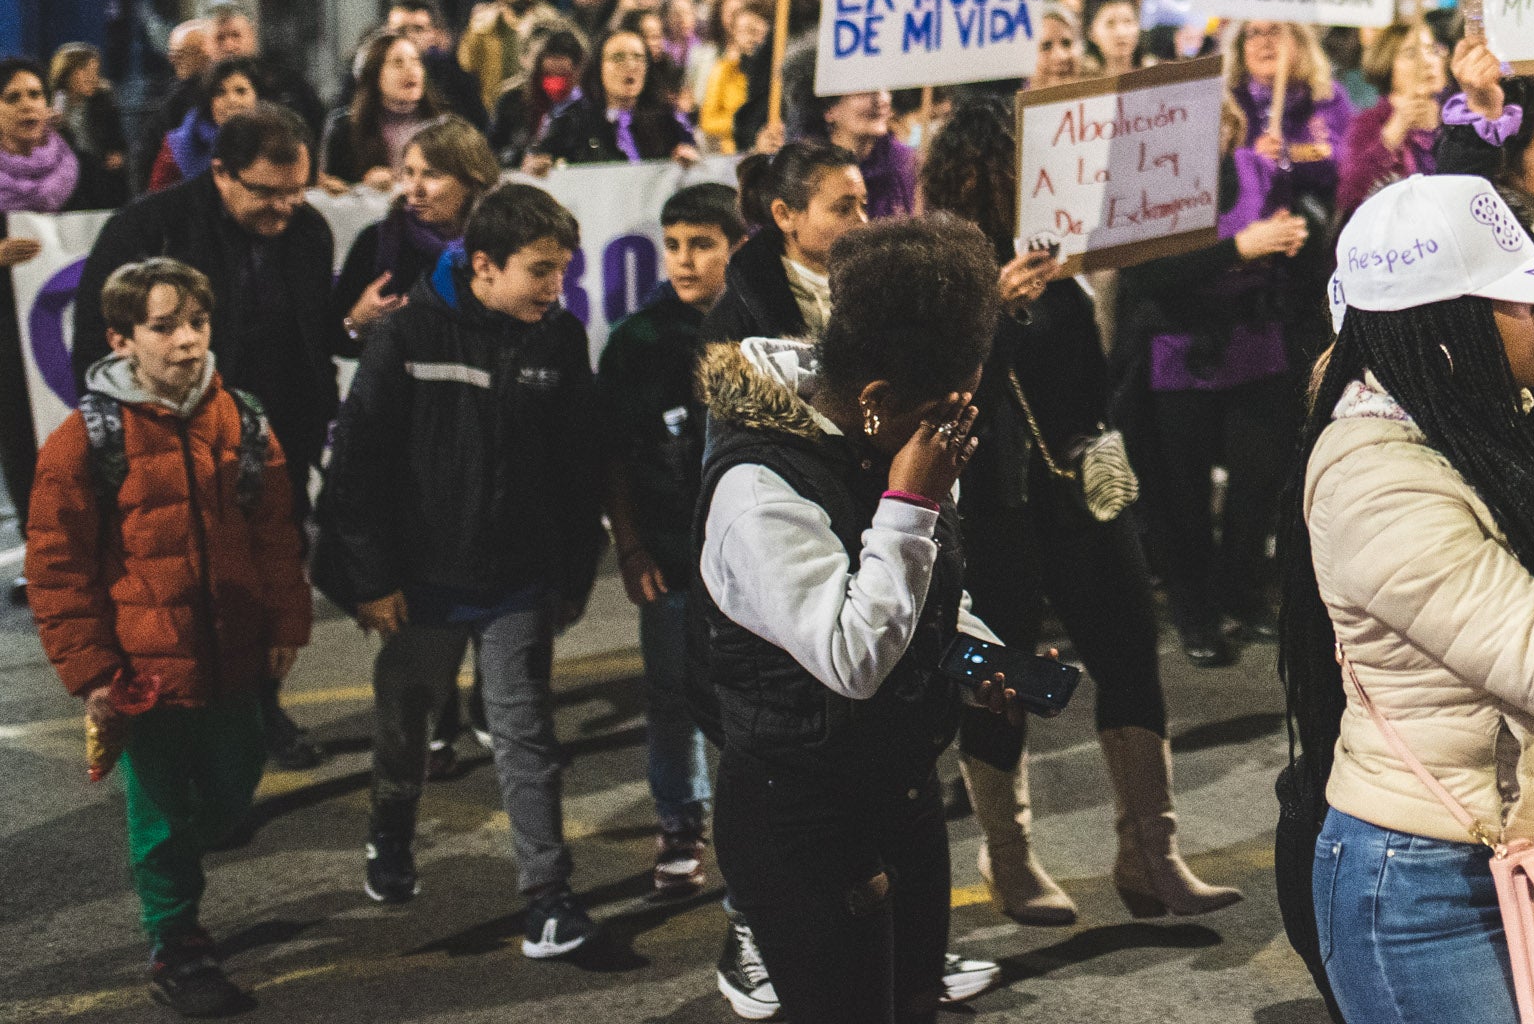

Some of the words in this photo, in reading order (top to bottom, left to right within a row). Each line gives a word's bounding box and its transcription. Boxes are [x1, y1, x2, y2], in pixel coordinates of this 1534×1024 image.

[834, 14, 885, 59] DE
[902, 4, 942, 53] MI
[954, 2, 1034, 49] VIDA
[1031, 167, 1056, 198] A
[1347, 238, 1439, 273] Respeto
